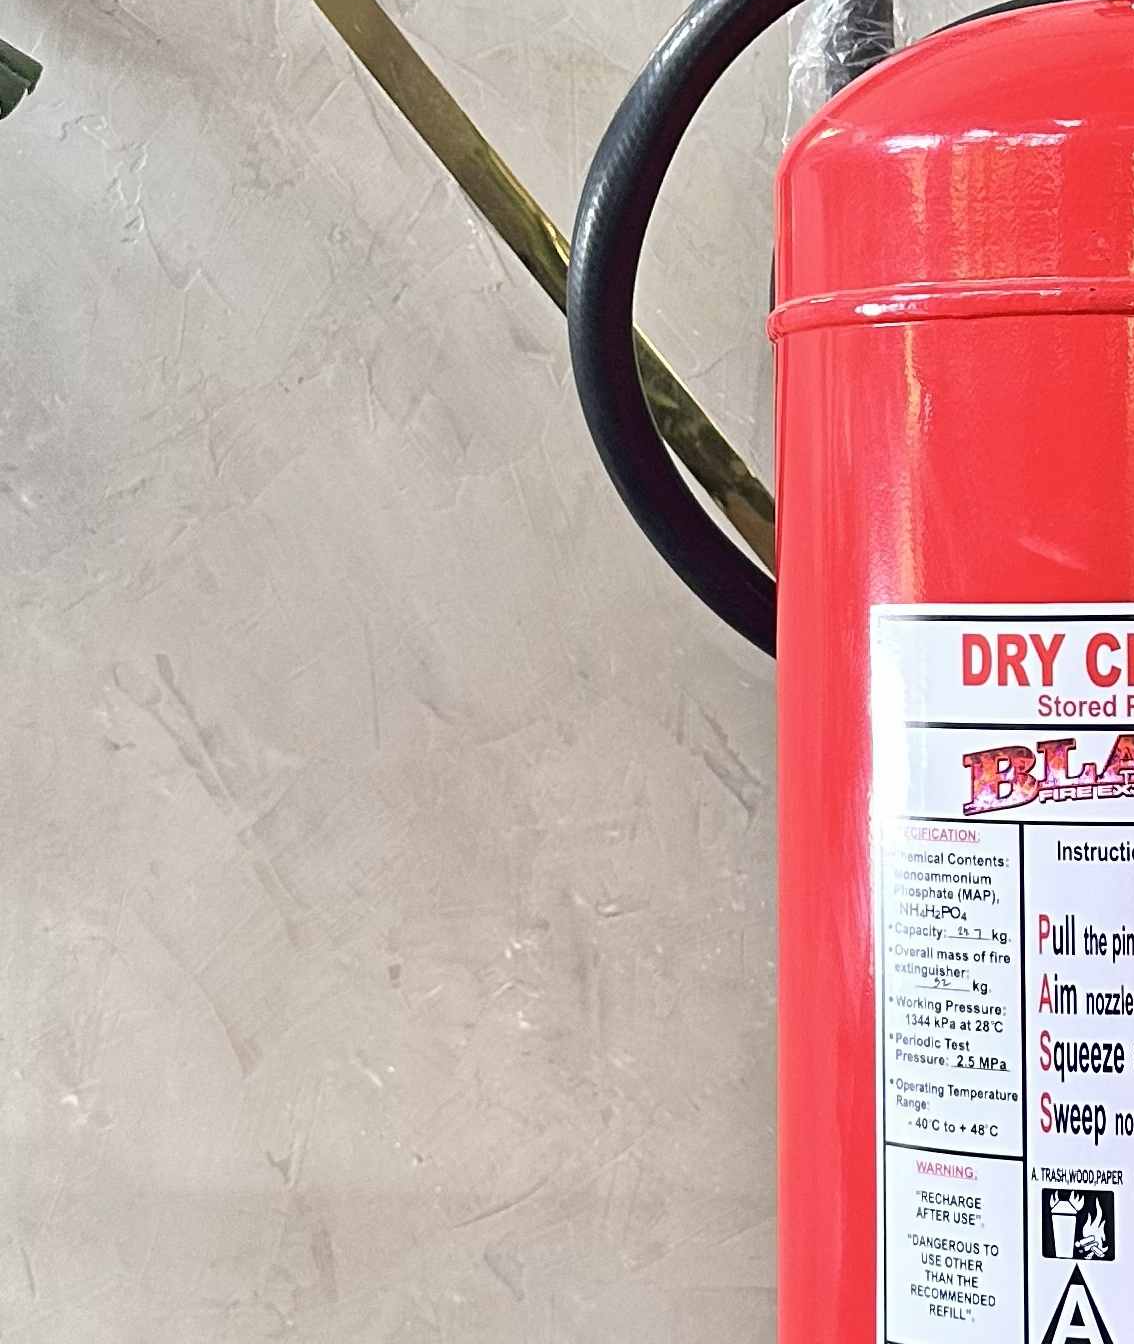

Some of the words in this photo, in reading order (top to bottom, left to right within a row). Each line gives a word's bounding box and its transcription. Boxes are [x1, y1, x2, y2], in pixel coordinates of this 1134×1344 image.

[961, 632, 1066, 687] DRY
[1038, 694, 1118, 719] Stored
[1038, 787, 1093, 802] FIRE
[948, 853, 1010, 868] Contents:
[894, 884, 953, 900] Phosphate
[958, 888, 999, 904] (MAP),
[895, 923, 947, 940] Capacity:
[1039, 914, 1075, 956] Pull
[1084, 925, 1107, 955] the
[1112, 926, 1134, 963] pin
[895, 944, 933, 958] Overall
[937, 950, 969, 961] mass
[973, 951, 986, 963] of
[990, 951, 1010, 964] fire
[895, 963, 969, 979] extinguisher:
[1039, 973, 1077, 1014] Aim
[1086, 986, 1133, 1016] nozzle
[896, 995, 941, 1013] Working
[946, 1000, 1006, 1016] Pressure:
[906, 1013, 930, 1027] 1344
[935, 1017, 955, 1029] kPa
[960, 1020, 971, 1031] at
[896, 1032, 941, 1048] Periodic
[945, 1038, 970, 1052] Test
[896, 1049, 949, 1066] Pressure:
[957, 1055, 975, 1068] 2.5
[980, 1057, 1007, 1070] MPa
[1040, 1030, 1125, 1082] Squeeze
[896, 1078, 944, 1098] Operating
[948, 1084, 1018, 1101] Temperature
[897, 1094, 930, 1112] Range:
[944, 1121, 955, 1133] to
[1040, 1092, 1106, 1146] Sweep
[917, 1160, 978, 1180] WARNING:
[1041, 1168, 1123, 1186] TRASH,WOOD,PAPER
[916, 1191, 981, 1209] "RECHARGE
[916, 1207, 950, 1222] AFTER
[908, 1234, 979, 1254] "DANGEROUS
[983, 1244, 998, 1256] TO
[921, 1252, 941, 1267] USE
[945, 1256, 983, 1272] OTHER
[925, 1270, 953, 1284] THAN
[957, 1275, 979, 1288] THE
[910, 1284, 995, 1307] RECOMMENDED
